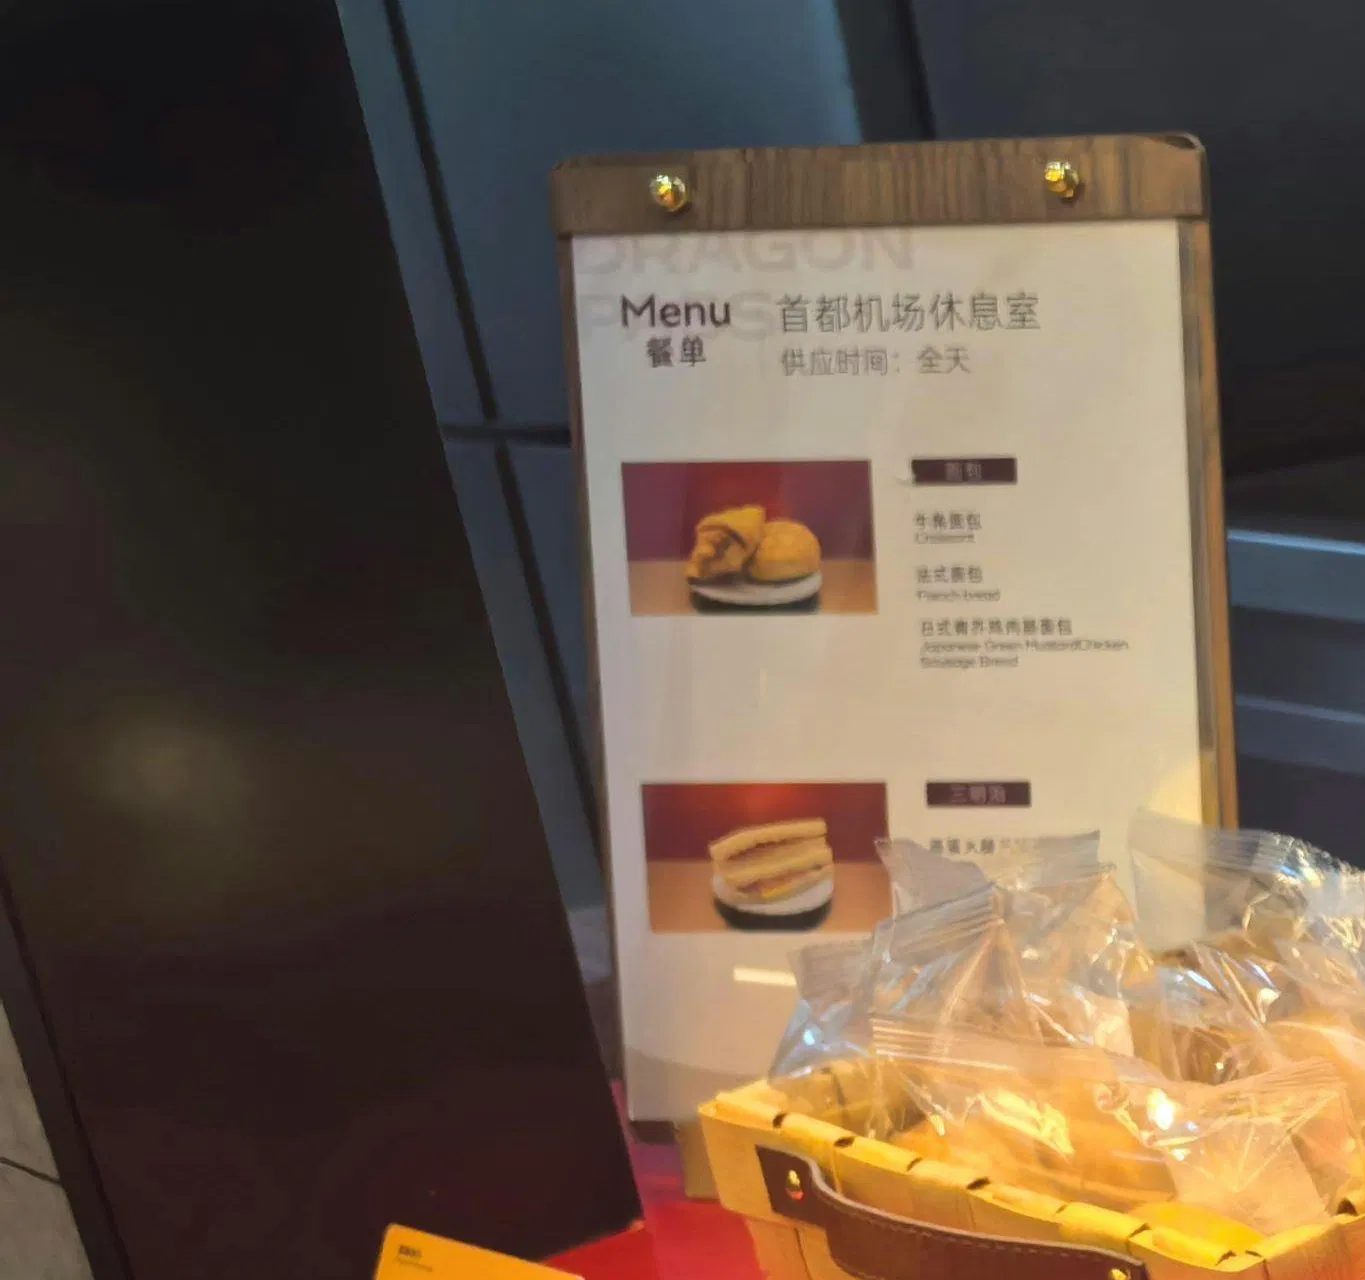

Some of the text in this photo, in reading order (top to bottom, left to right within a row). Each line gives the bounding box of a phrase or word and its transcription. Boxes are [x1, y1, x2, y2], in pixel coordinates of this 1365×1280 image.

[620, 294, 731, 328] Menu
[777, 291, 1041, 333] 首都机场休息室
[646, 336, 706, 368] 餐单
